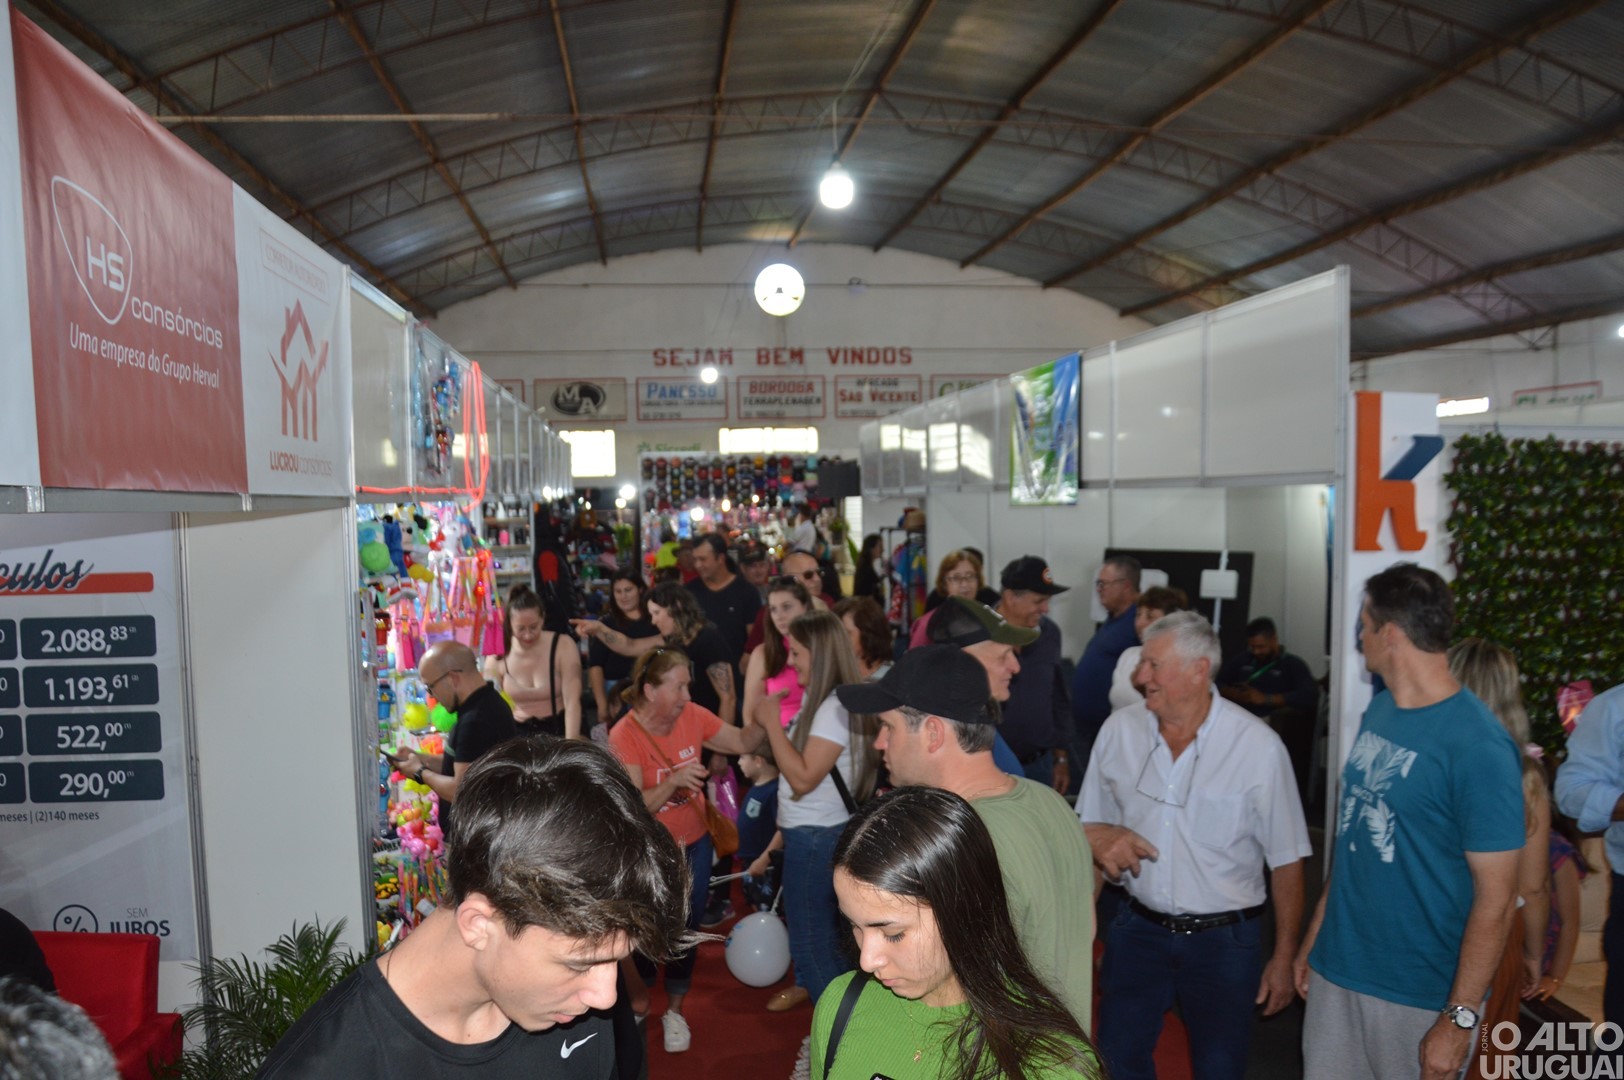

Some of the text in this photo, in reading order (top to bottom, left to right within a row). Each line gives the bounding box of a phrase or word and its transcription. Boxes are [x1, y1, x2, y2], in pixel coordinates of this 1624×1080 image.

[86, 236, 125, 292] HS
[131, 297, 223, 350] consórcios
[70, 322, 220, 389] Uma empresa do Grupo Herval
[652, 346, 913, 367] SEJAM BEM VINDOS
[270, 449, 299, 473] LUCROU
[68, 812, 100, 822] meses
[126, 907, 149, 918] SEM
